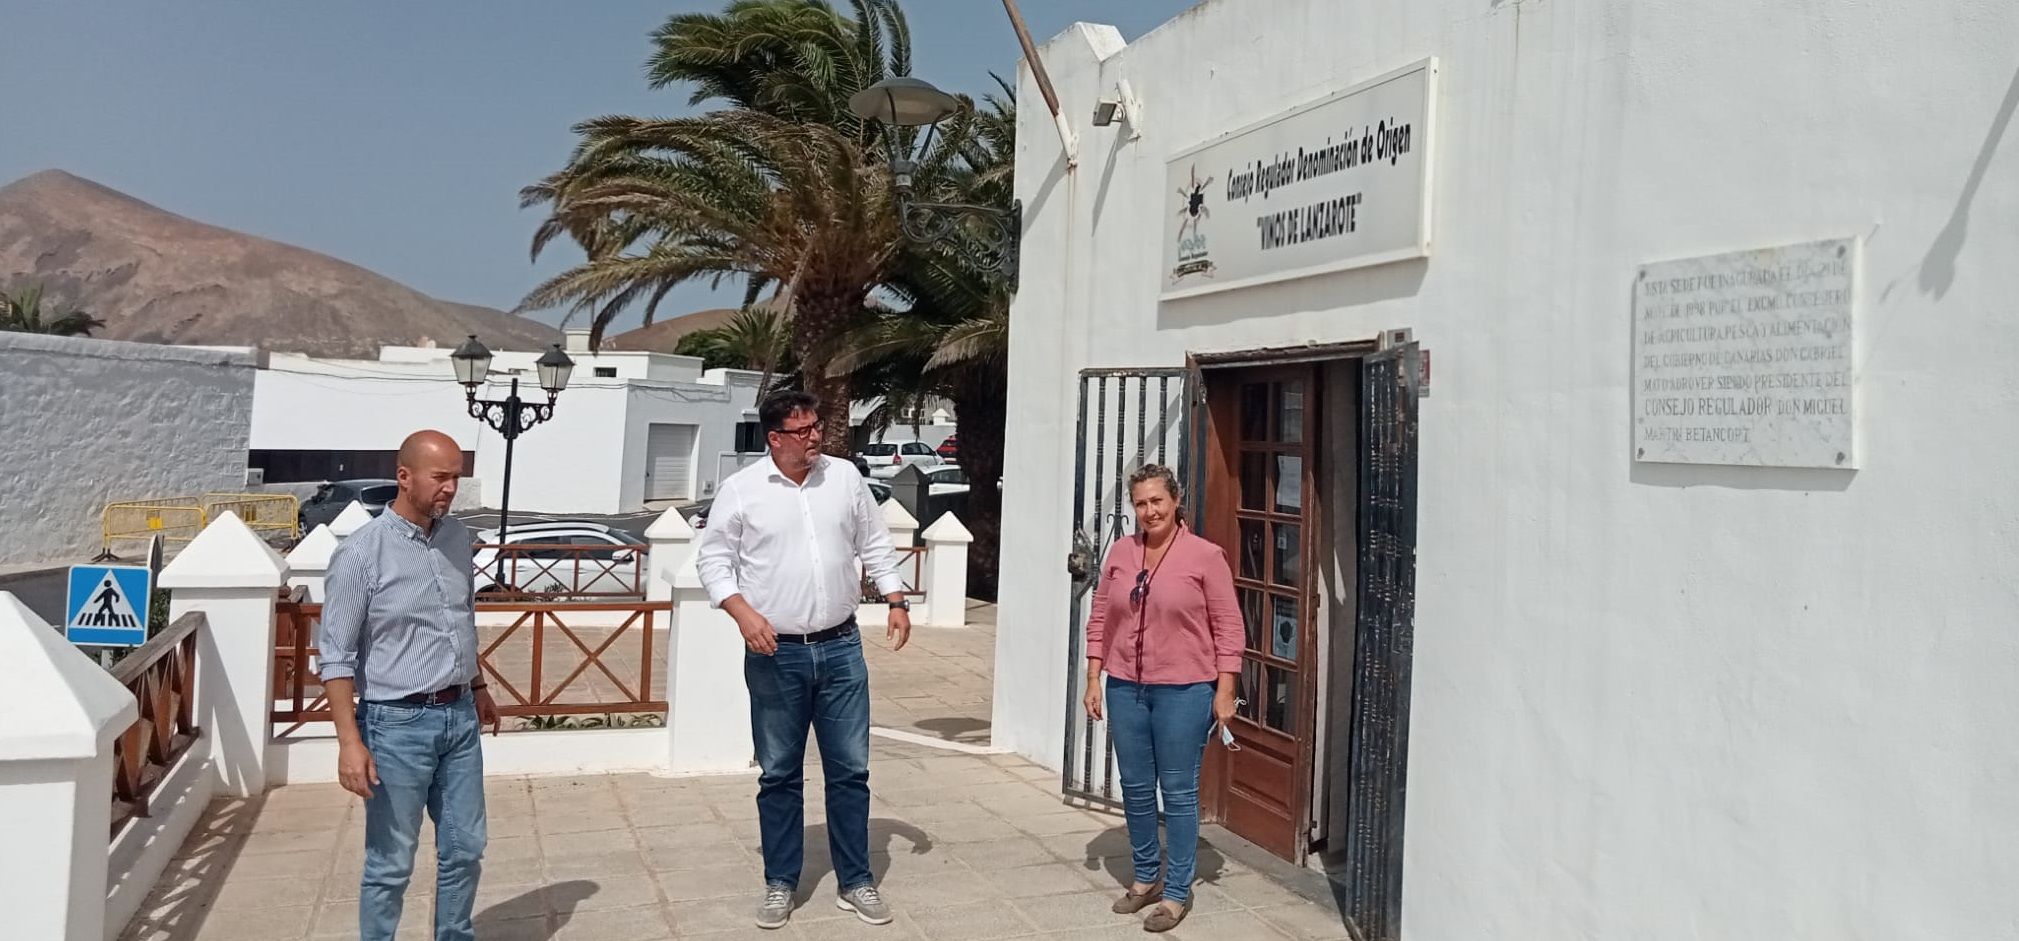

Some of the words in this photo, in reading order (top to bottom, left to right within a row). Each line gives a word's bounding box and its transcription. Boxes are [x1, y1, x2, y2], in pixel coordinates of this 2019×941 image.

[1227, 162, 1253, 203] Consejo
[1255, 152, 1295, 199] Regulador
[1297, 127, 1358, 182] Denominación
[1361, 125, 1373, 164] de
[1377, 116, 1411, 166] Origen
[1287, 208, 1299, 245] DE
[1300, 192, 1362, 243] LANZAROTE"
[1645, 397, 1695, 416] CONSEJO
[1698, 397, 1772, 416] REGULADOR
